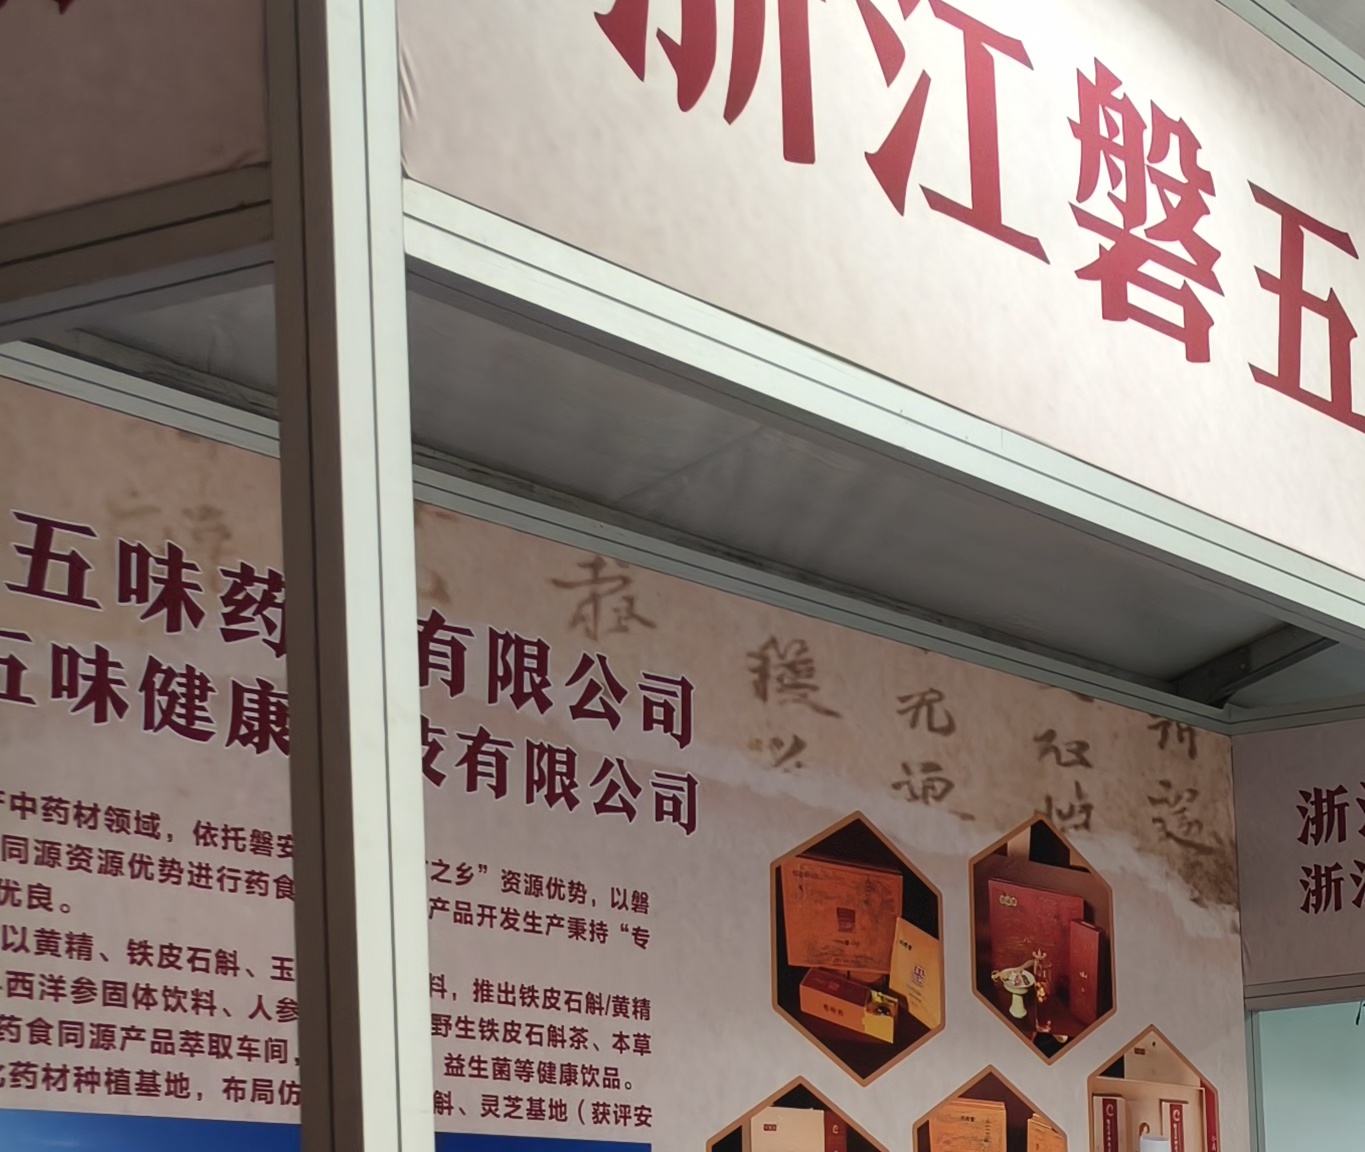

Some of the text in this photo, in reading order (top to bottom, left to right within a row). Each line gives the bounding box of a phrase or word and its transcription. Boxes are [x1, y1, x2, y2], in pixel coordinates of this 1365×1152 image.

[0, 790, 294, 860] 中药材领域，依托磐安
